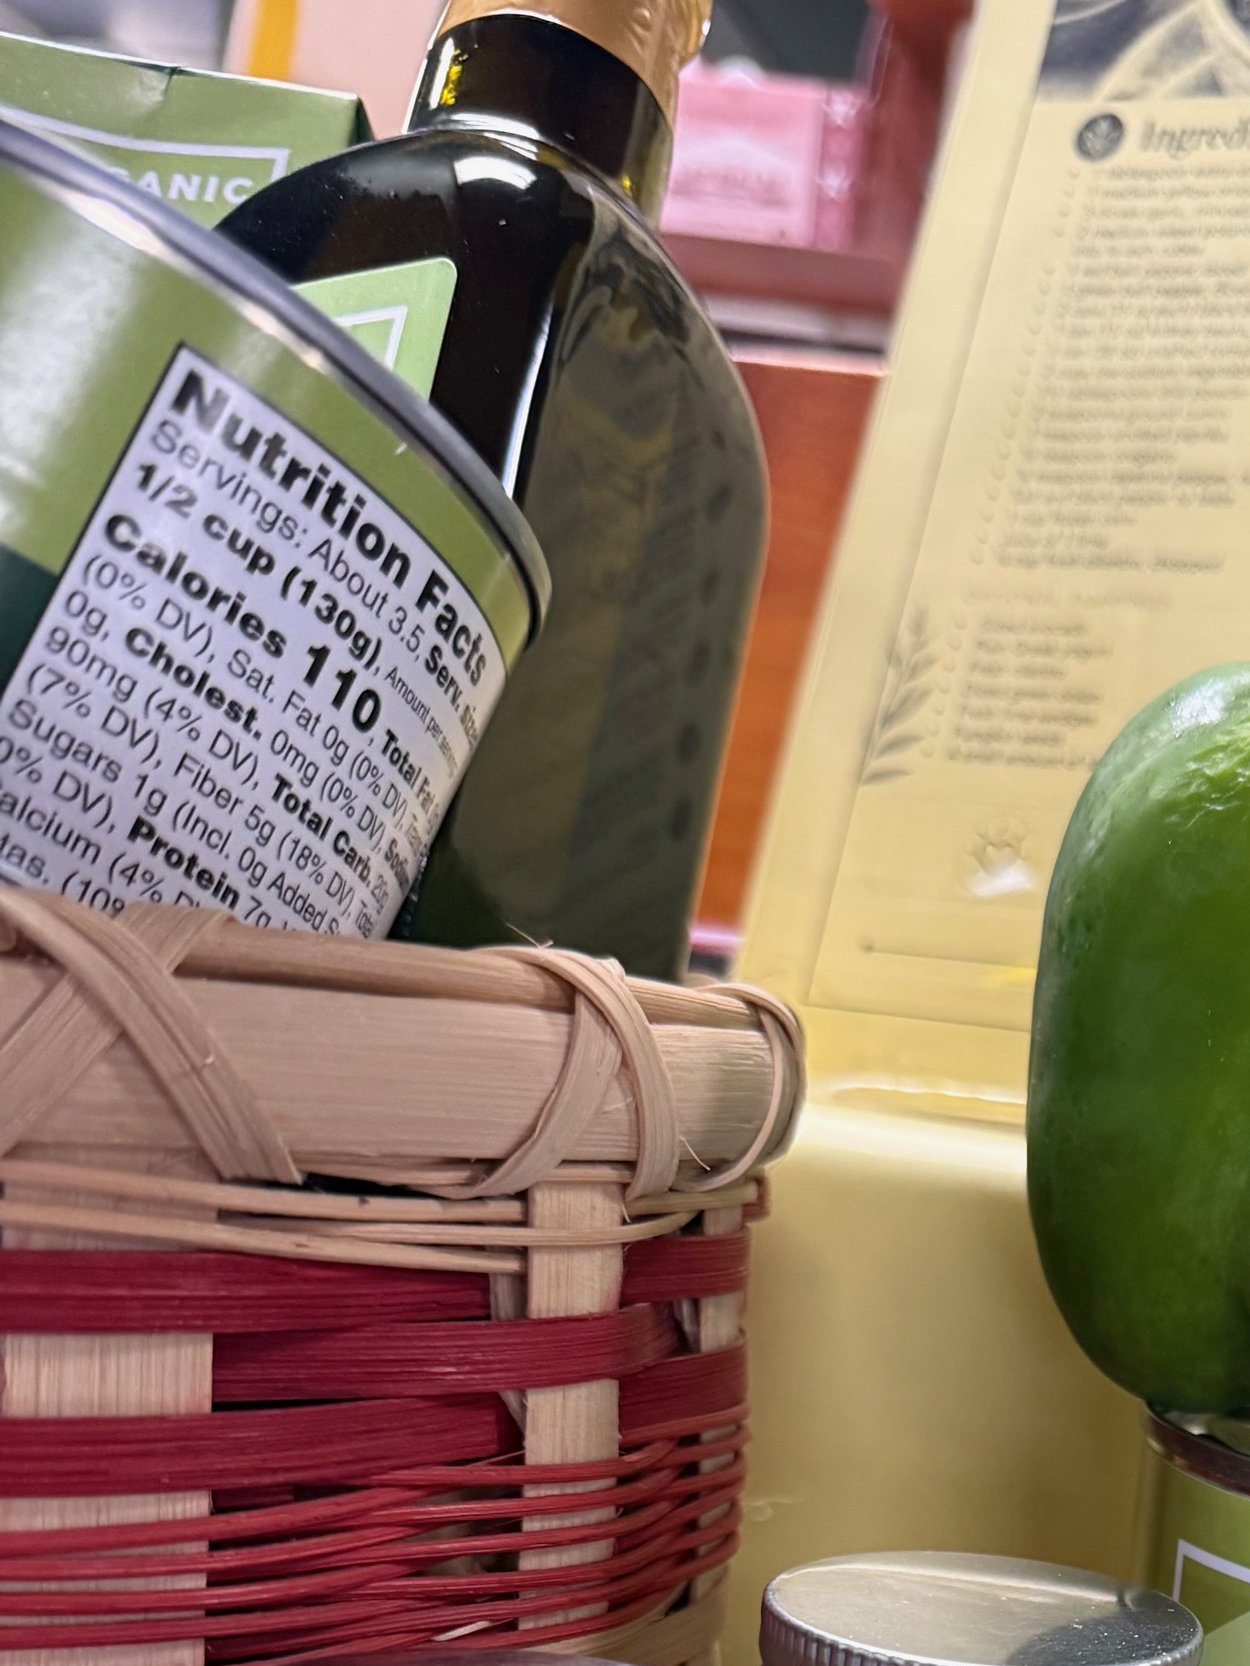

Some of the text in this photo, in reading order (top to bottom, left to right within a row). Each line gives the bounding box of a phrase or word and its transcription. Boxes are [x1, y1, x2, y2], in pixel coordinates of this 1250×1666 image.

[137, 463, 199, 519] 1/2
[202, 513, 276, 576] cup
[280, 565, 383, 676] (130g),
[384, 666, 432, 724] Amount
[152, 420, 308, 549] Servings:
[308, 537, 389, 619] About
[388, 606, 425, 662] 3.5,
[424, 644, 463, 713] Serv.
[170, 369, 487, 687] Nutrition Facts
[46, 626, 138, 703] 90mg
[144, 687, 202, 742] (4%
[208, 729, 259, 791] DV),
[270, 772, 333, 842] Total
[332, 829, 372, 888] Carb.
[64, 590, 109, 642] 0g,
[125, 627, 262, 741] Cholest.
[270, 729, 320, 788] 0mg
[320, 771, 361, 819] (0%
[83, 554, 148, 612] (0%
[156, 598, 216, 664] DV),
[228, 648, 275, 704] Sat.
[282, 689, 323, 738] Fat
[322, 725, 350, 767] 0g
[350, 750, 384, 797] (0%
[104, 514, 288, 660] Calories
[381, 728, 421, 791] Total
[8, 699, 328, 931] Sugars 1g (Incl. 0g Added
[27, 663, 91, 718] (7%
[100, 705, 161, 770] DV),
[174, 752, 244, 814] Fiber
[244, 803, 276, 847] 5g
[278, 830, 327, 886] (18%
[53, 770, 115, 835] DV),
[127, 815, 240, 912] Protein
[108, 852, 165, 904] (4%
